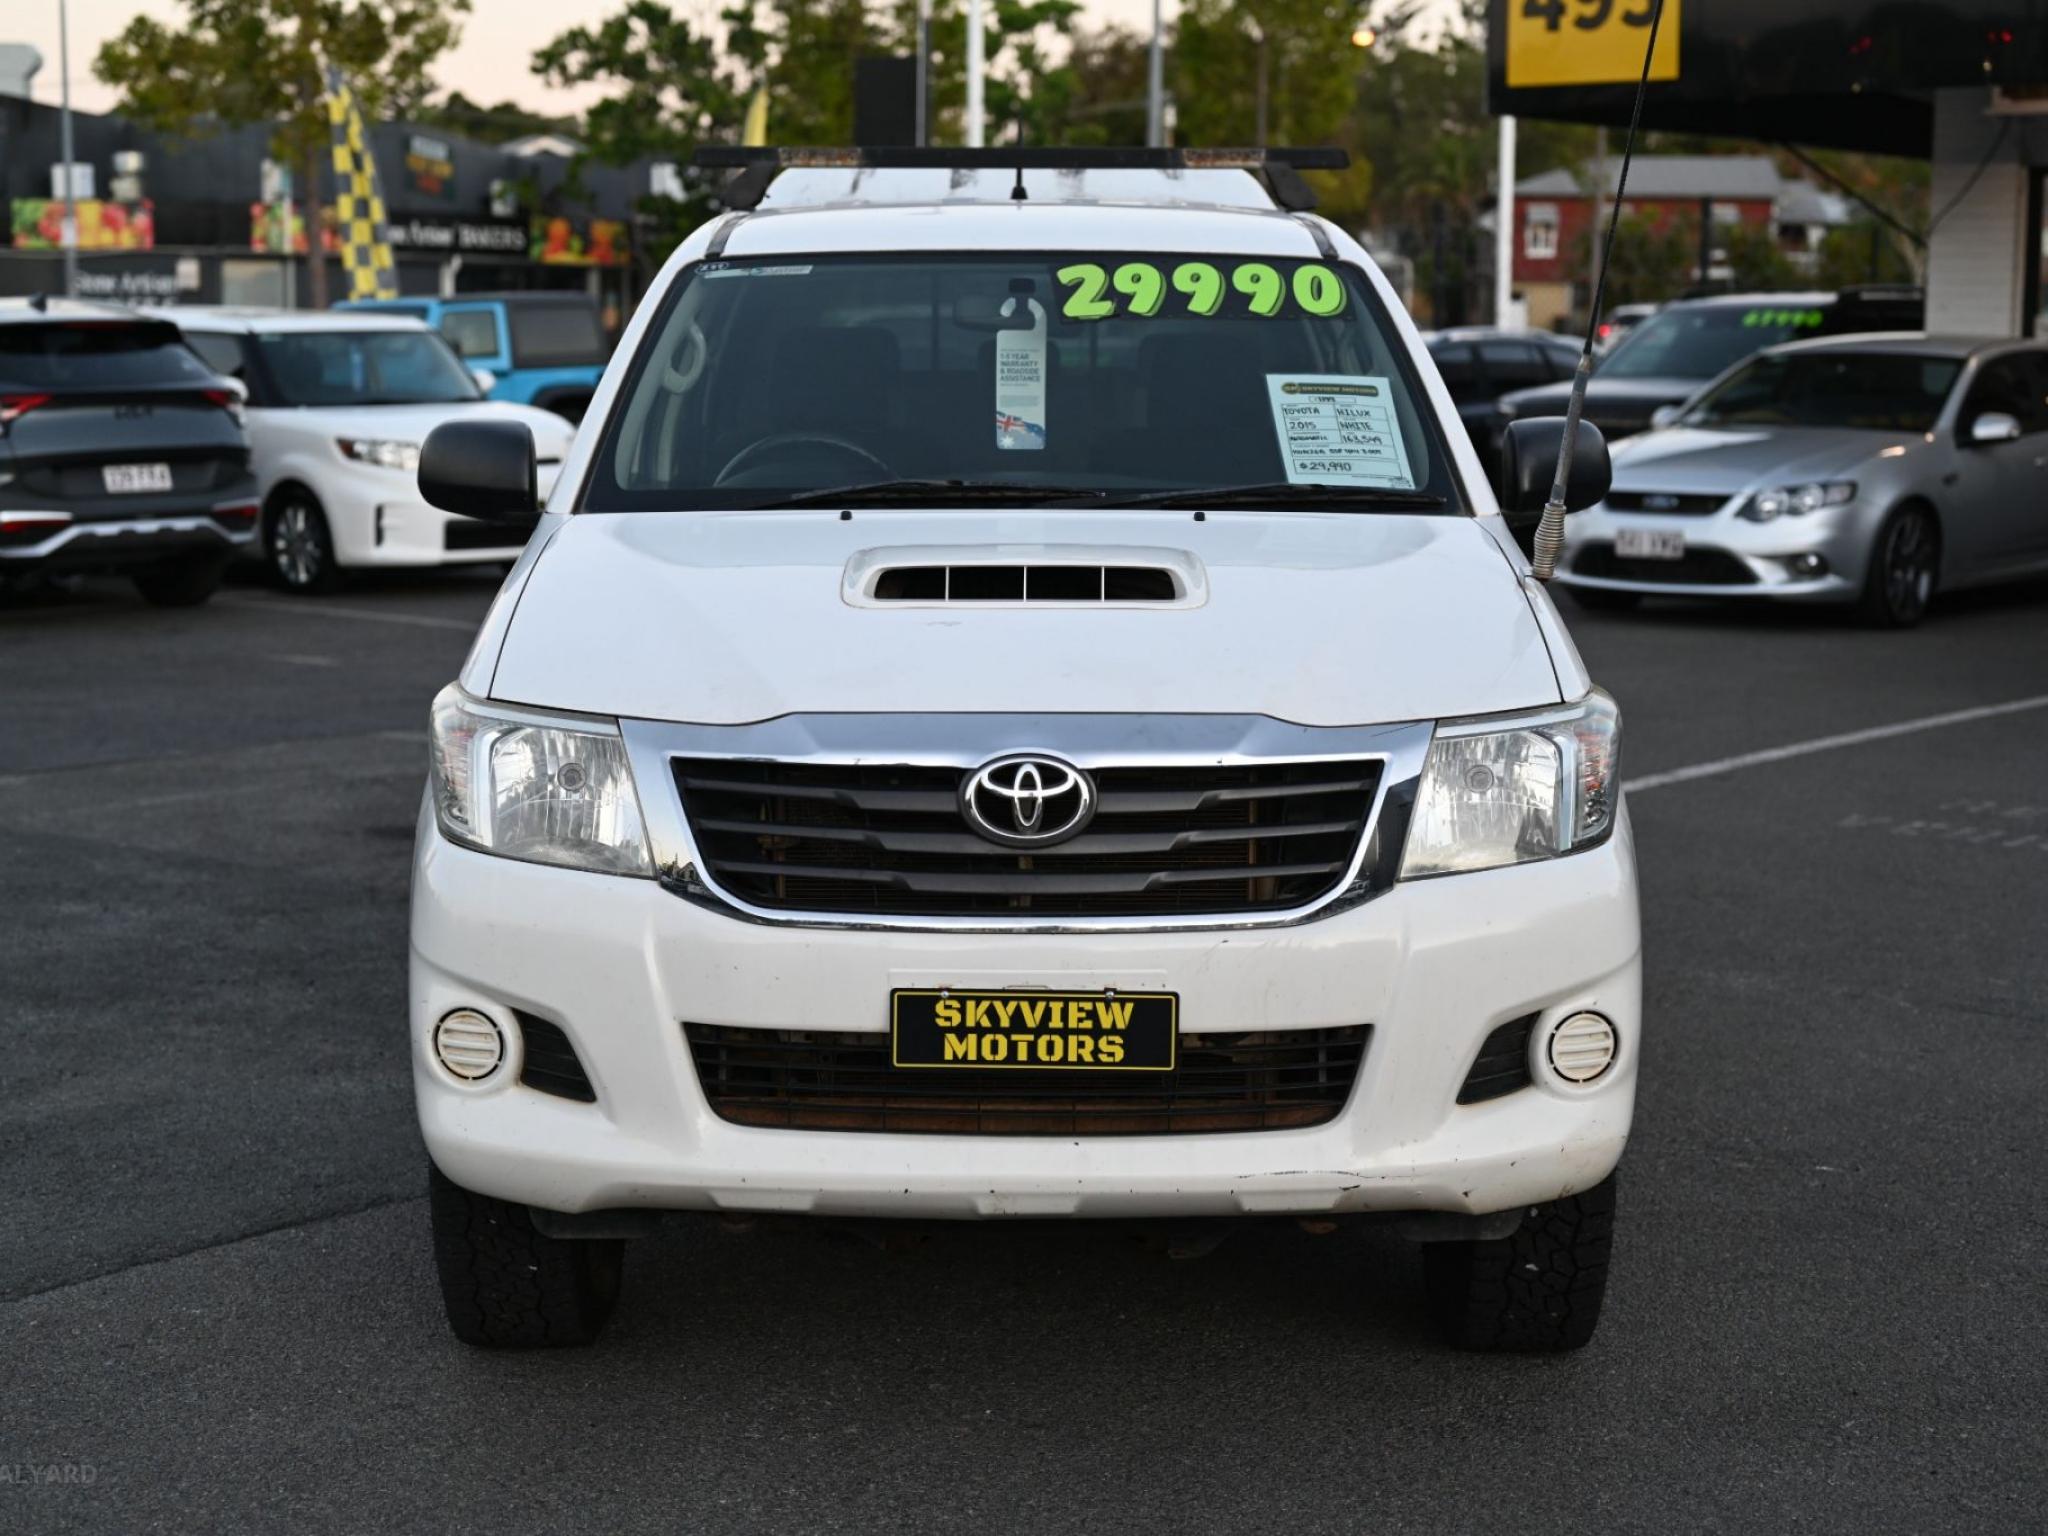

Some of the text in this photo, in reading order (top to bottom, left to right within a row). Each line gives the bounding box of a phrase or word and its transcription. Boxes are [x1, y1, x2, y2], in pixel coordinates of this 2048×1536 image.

[1056, 262, 1347, 319] 29990
[1283, 407, 1371, 417] TOYOTA HILUX
[1288, 421, 1317, 429] 2015
[934, 999, 1134, 1030] SKYVIEW
[943, 1033, 1125, 1063] MOTORS
